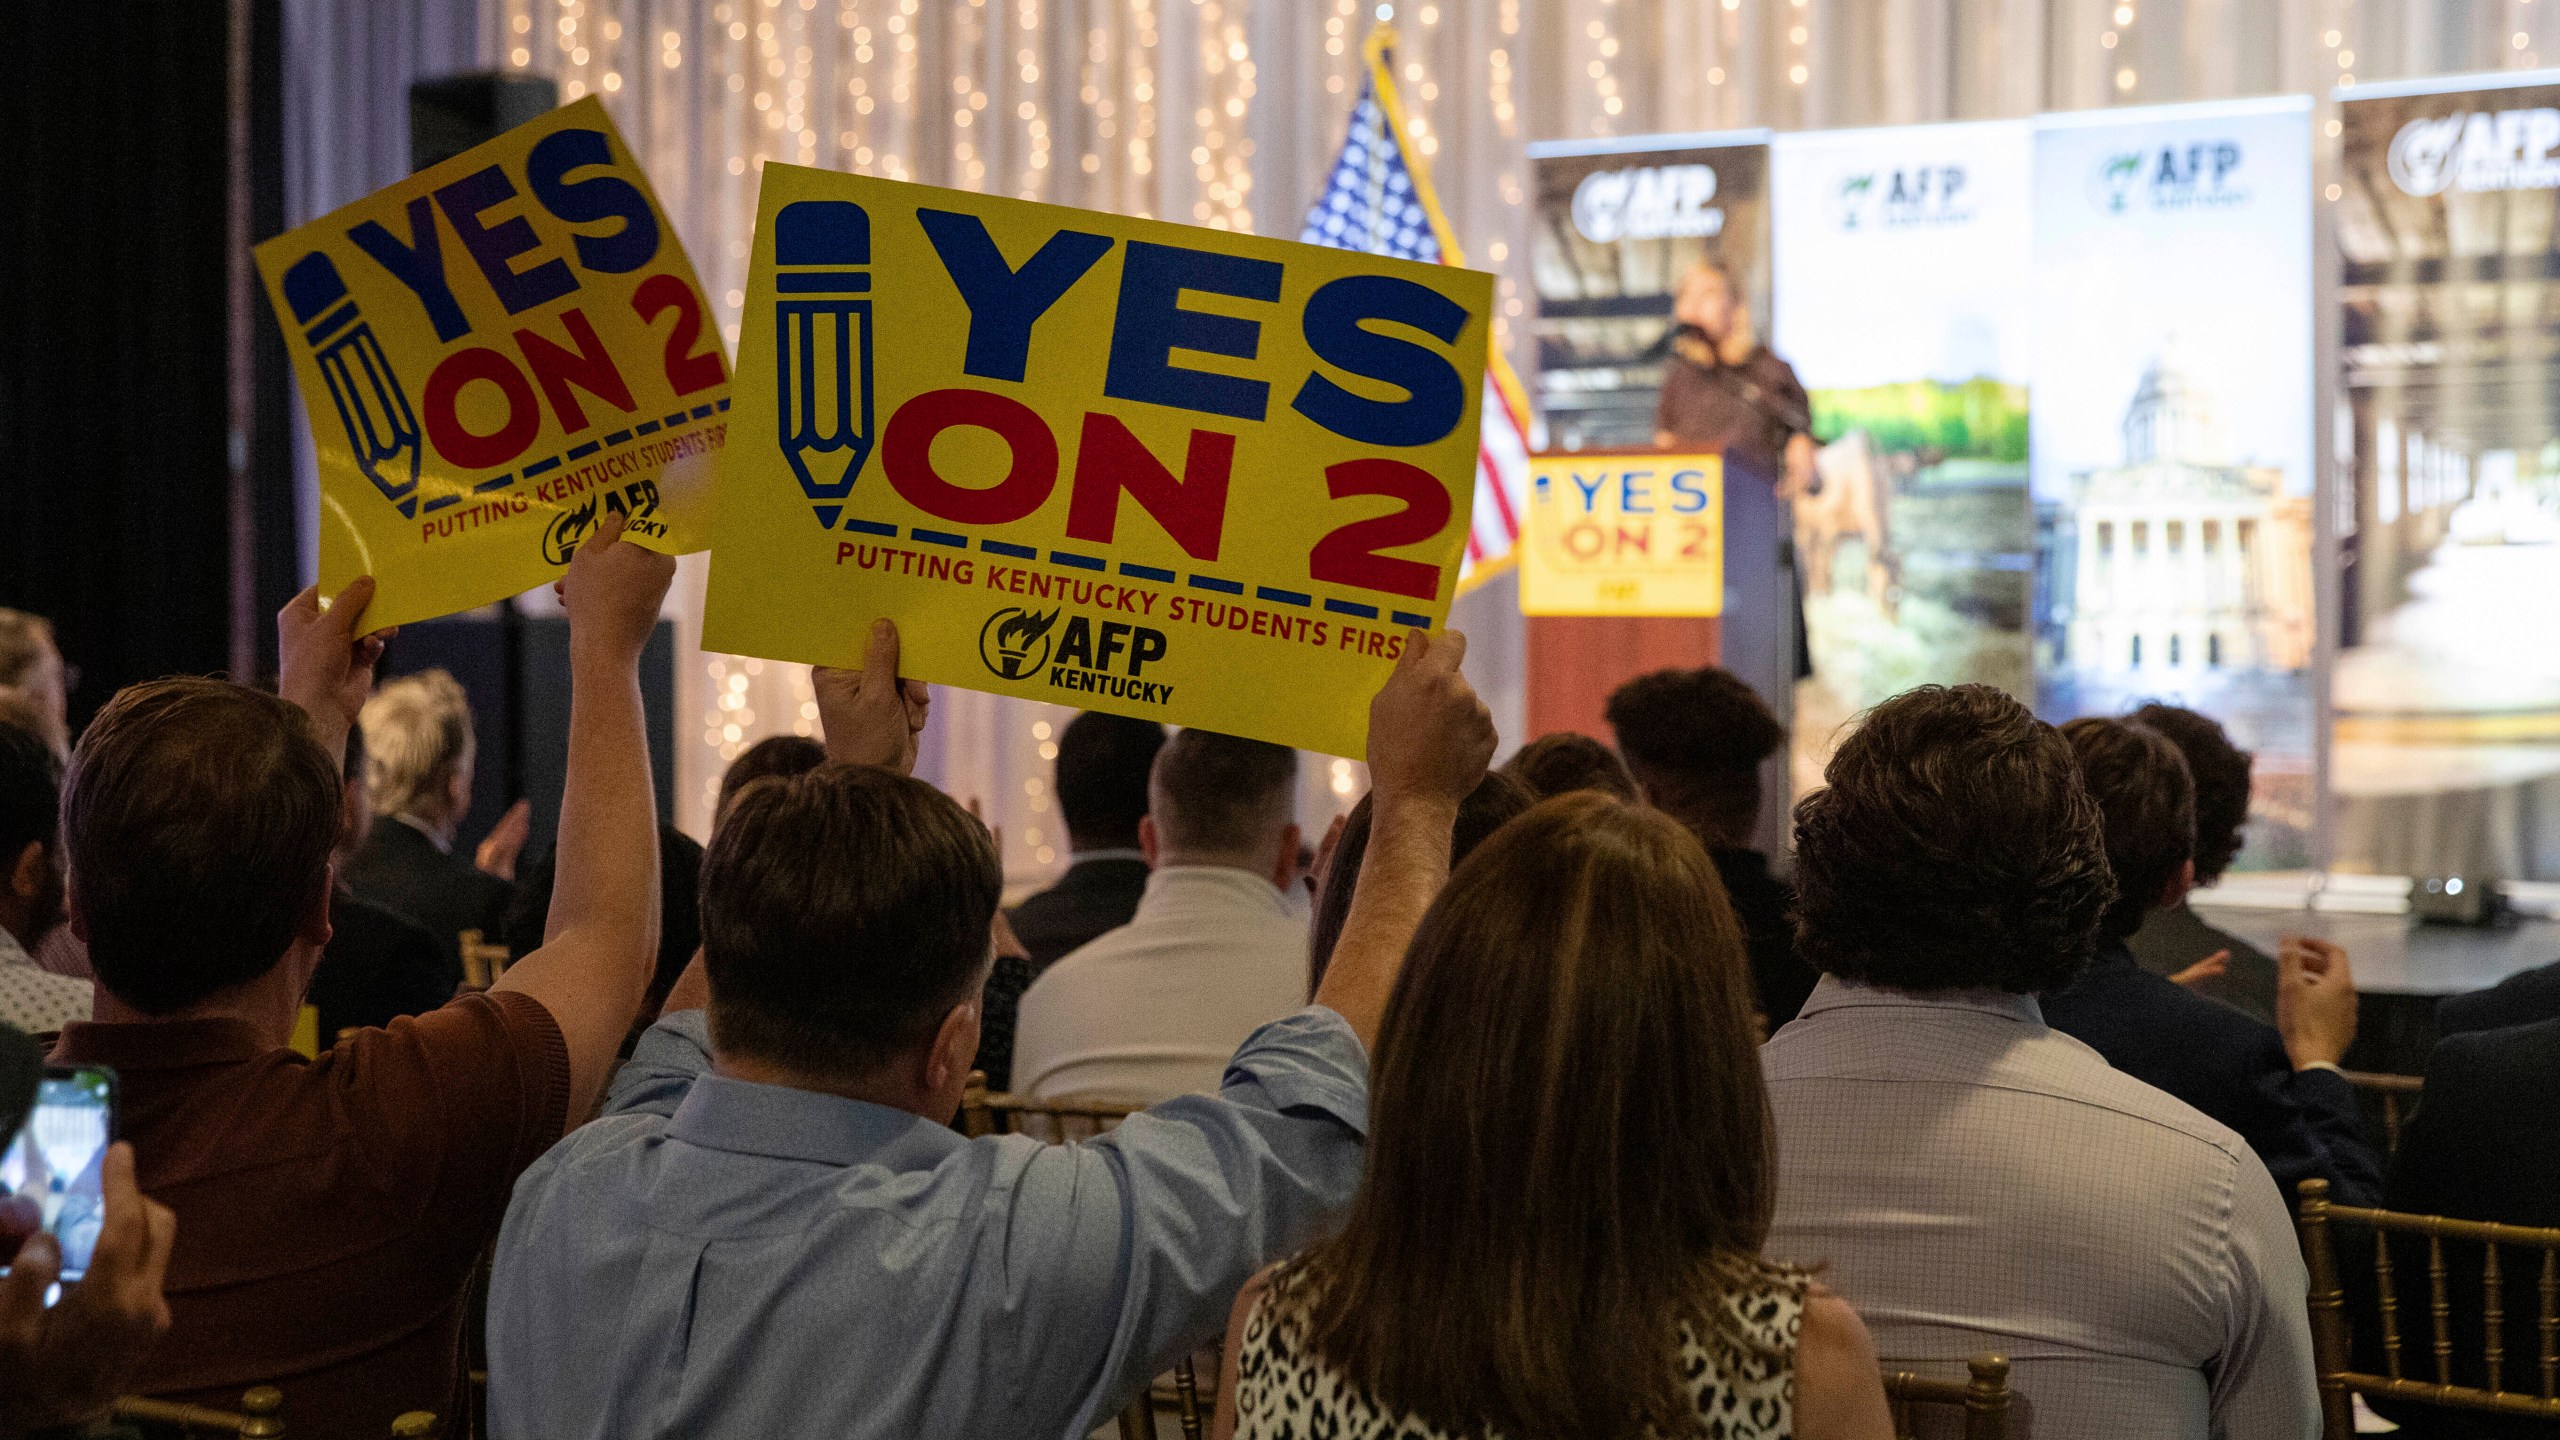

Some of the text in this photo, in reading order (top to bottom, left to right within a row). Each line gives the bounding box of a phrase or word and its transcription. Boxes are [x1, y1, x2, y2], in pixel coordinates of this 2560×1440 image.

[345, 127, 662, 344] YES
[423, 274, 725, 469] ON 2
[916, 208, 1470, 447] YES
[422, 491, 529, 544] PUTTING
[536, 450, 640, 503] KENTUCKY
[639, 430, 706, 468] STUDENTS
[604, 479, 660, 518] AFP
[882, 389, 1451, 600] ON 2
[1563, 523, 1708, 561] ON 2
[1571, 469, 1708, 514] YES
[836, 541, 1408, 660] PUTTING KENTUCKY STUDENTS FIRS
[1053, 615, 1168, 677] AFP
[1050, 666, 1175, 706] KENTUCKY
